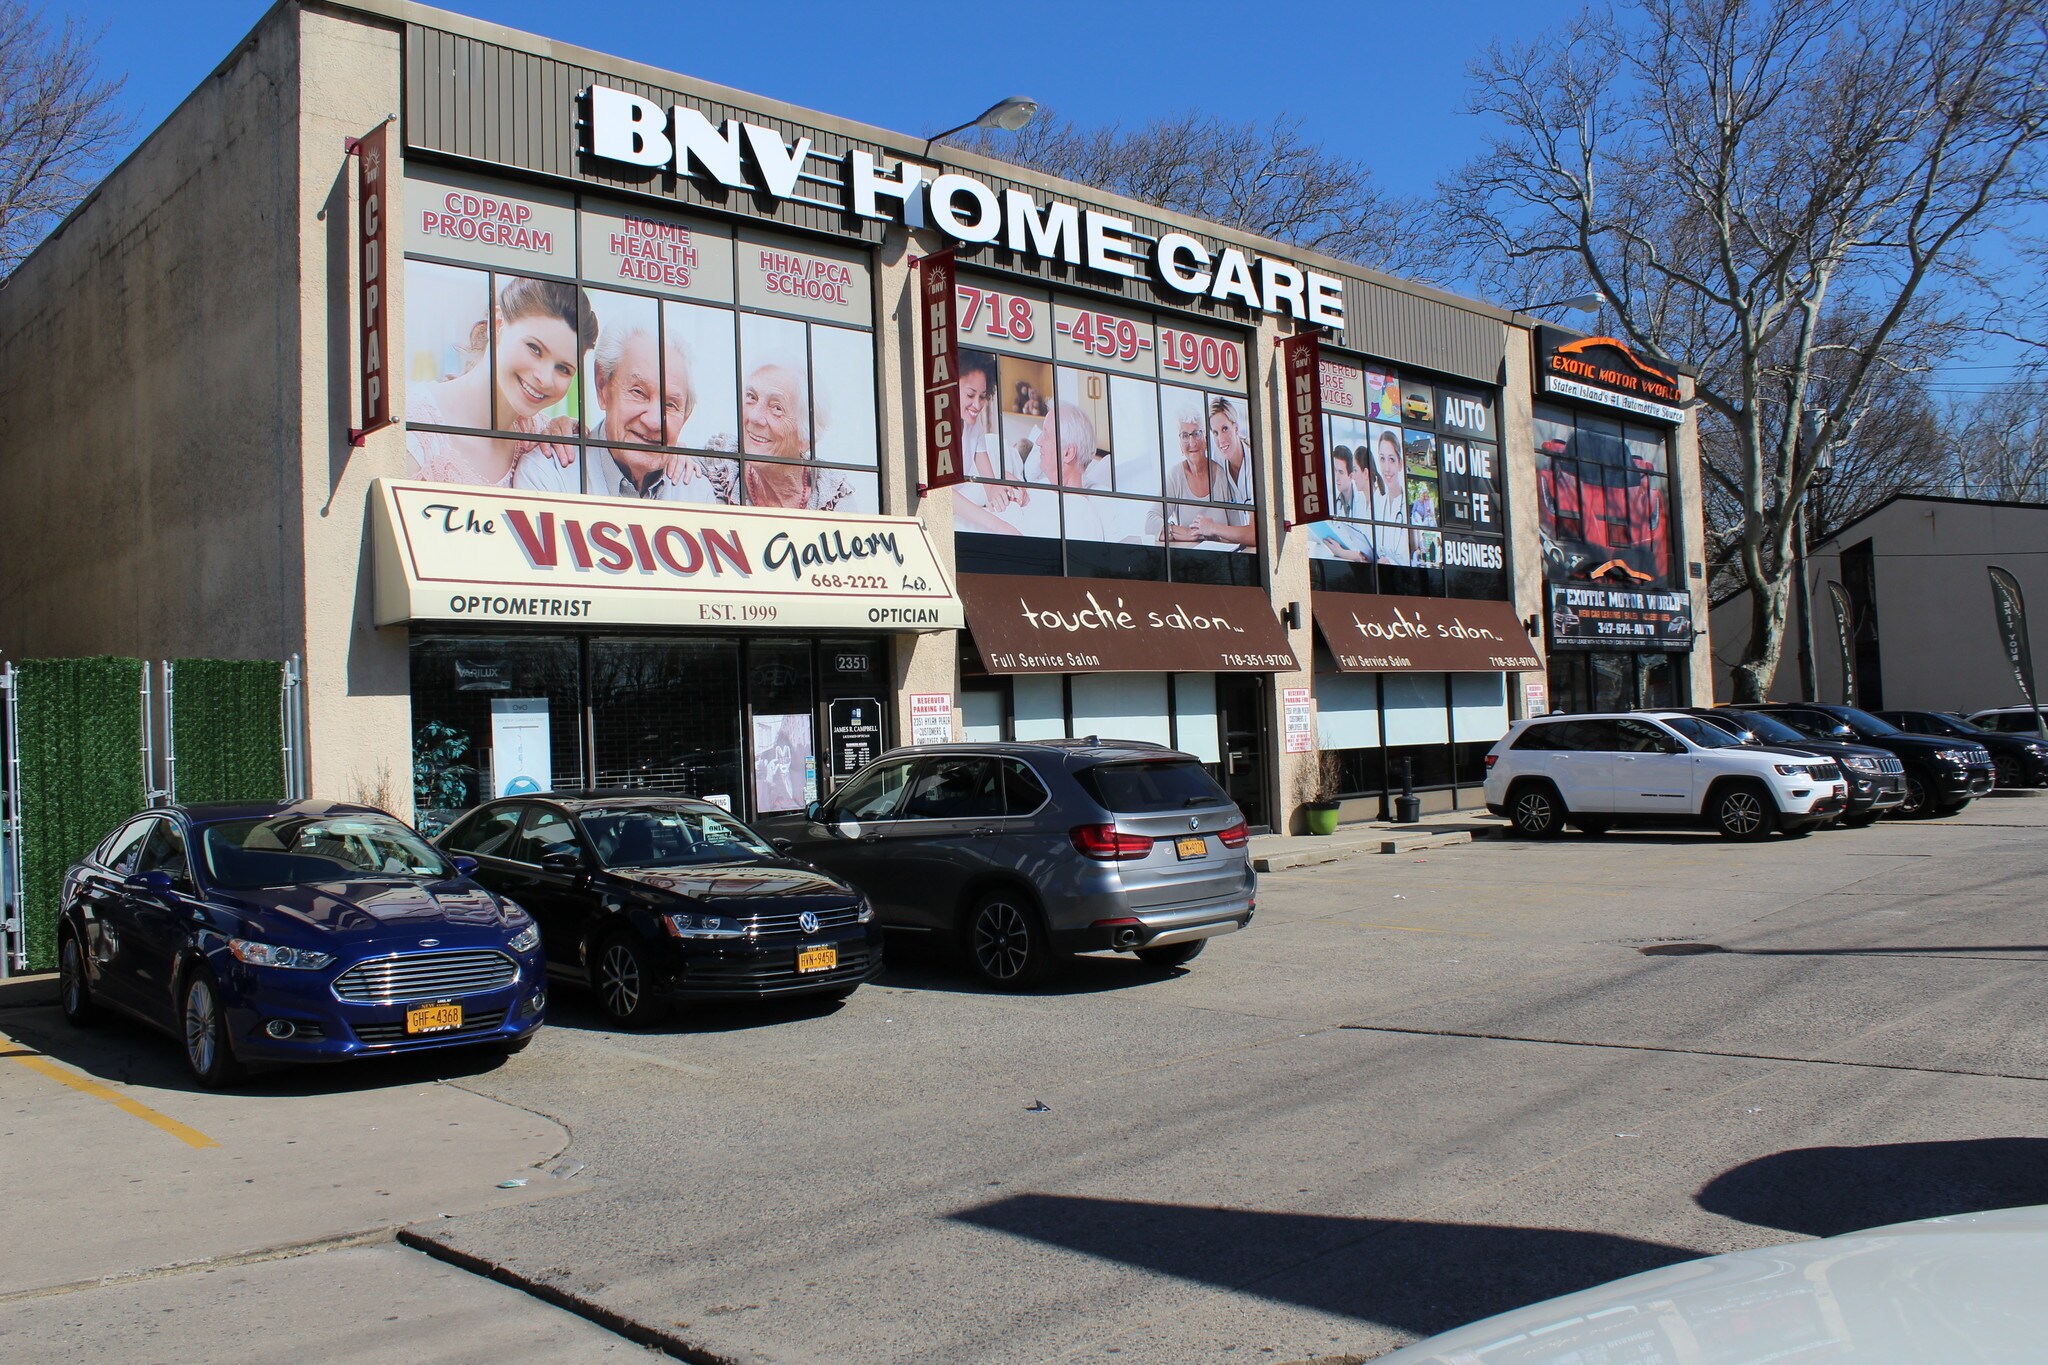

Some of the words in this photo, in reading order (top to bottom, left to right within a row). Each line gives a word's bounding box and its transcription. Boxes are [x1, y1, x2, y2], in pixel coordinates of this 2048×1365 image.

[444, 191, 532, 227] CDPAP
[591, 84, 812, 199] BNV
[849, 149, 1136, 278] HOME
[1156, 232, 1344, 330] CARE
[421, 208, 553, 255] PROGRAM
[623, 213, 690, 246] HOME
[609, 232, 698, 269] HEALTH
[618, 256, 690, 289] AIDES
[759, 250, 853, 287] HHA/PCA
[765, 272, 849, 306] SCHOOL
[365, 193, 381, 419] CDPAP
[930, 300, 950, 384] HHA
[956, 284, 1034, 343] 718
[1160, 328, 1240, 382] 1900
[1319, 374, 1345, 391] URSE
[1551, 355, 1597, 380] EXOTIC
[1599, 367, 1638, 391] MOTOR
[1641, 379, 1682, 402] WORLD
[1444, 396, 1486, 433] AUTO
[1551, 377, 1578, 396] Staten
[1579, 383, 1608, 404] Island's
[1610, 393, 1620, 407] #1
[1621, 396, 1660, 416] Automotive
[1660, 407, 1684, 423] Source
[934, 393, 954, 477] PCA
[1295, 373, 1320, 515] NURSING
[421, 504, 497, 536] The
[500, 508, 753, 580] VISION
[762, 529, 905, 582] Gallery
[1444, 540, 1503, 570] BUSINESS
[810, 574, 889, 590] 668-2222
[449, 595, 592, 618] OPTOMETRIST
[698, 603, 737, 621] EST.
[740, 604, 778, 622] 1999
[867, 607, 940, 624] OPTICIAN
[1020, 590, 1136, 632] touché
[1148, 603, 1231, 630] salon
[1565, 588, 1606, 607] EXOTIC
[1608, 591, 1645, 610] MOTOR
[1646, 594, 1682, 612] WORLD
[1351, 606, 1431, 640] touché
[1437, 617, 1496, 640] salon
[1597, 622, 1655, 636] 347-674-AUTO
[459, 668, 498, 679] VARILUX
[838, 656, 866, 669] 2351
[990, 653, 1017, 668] Full
[1019, 652, 1064, 668] Service
[1066, 652, 1100, 666] Salon
[1221, 653, 1293, 666] 718-351-9700
[1340, 655, 1358, 667] Full
[1359, 655, 1388, 667] Service
[1388, 655, 1412, 667] Salon
[1489, 656, 1539, 668] 718-351-9700
[913, 705, 937, 713] PARKING
[917, 696, 945, 705] RESERVED
[412, 1007, 459, 1027] GHF-4368
